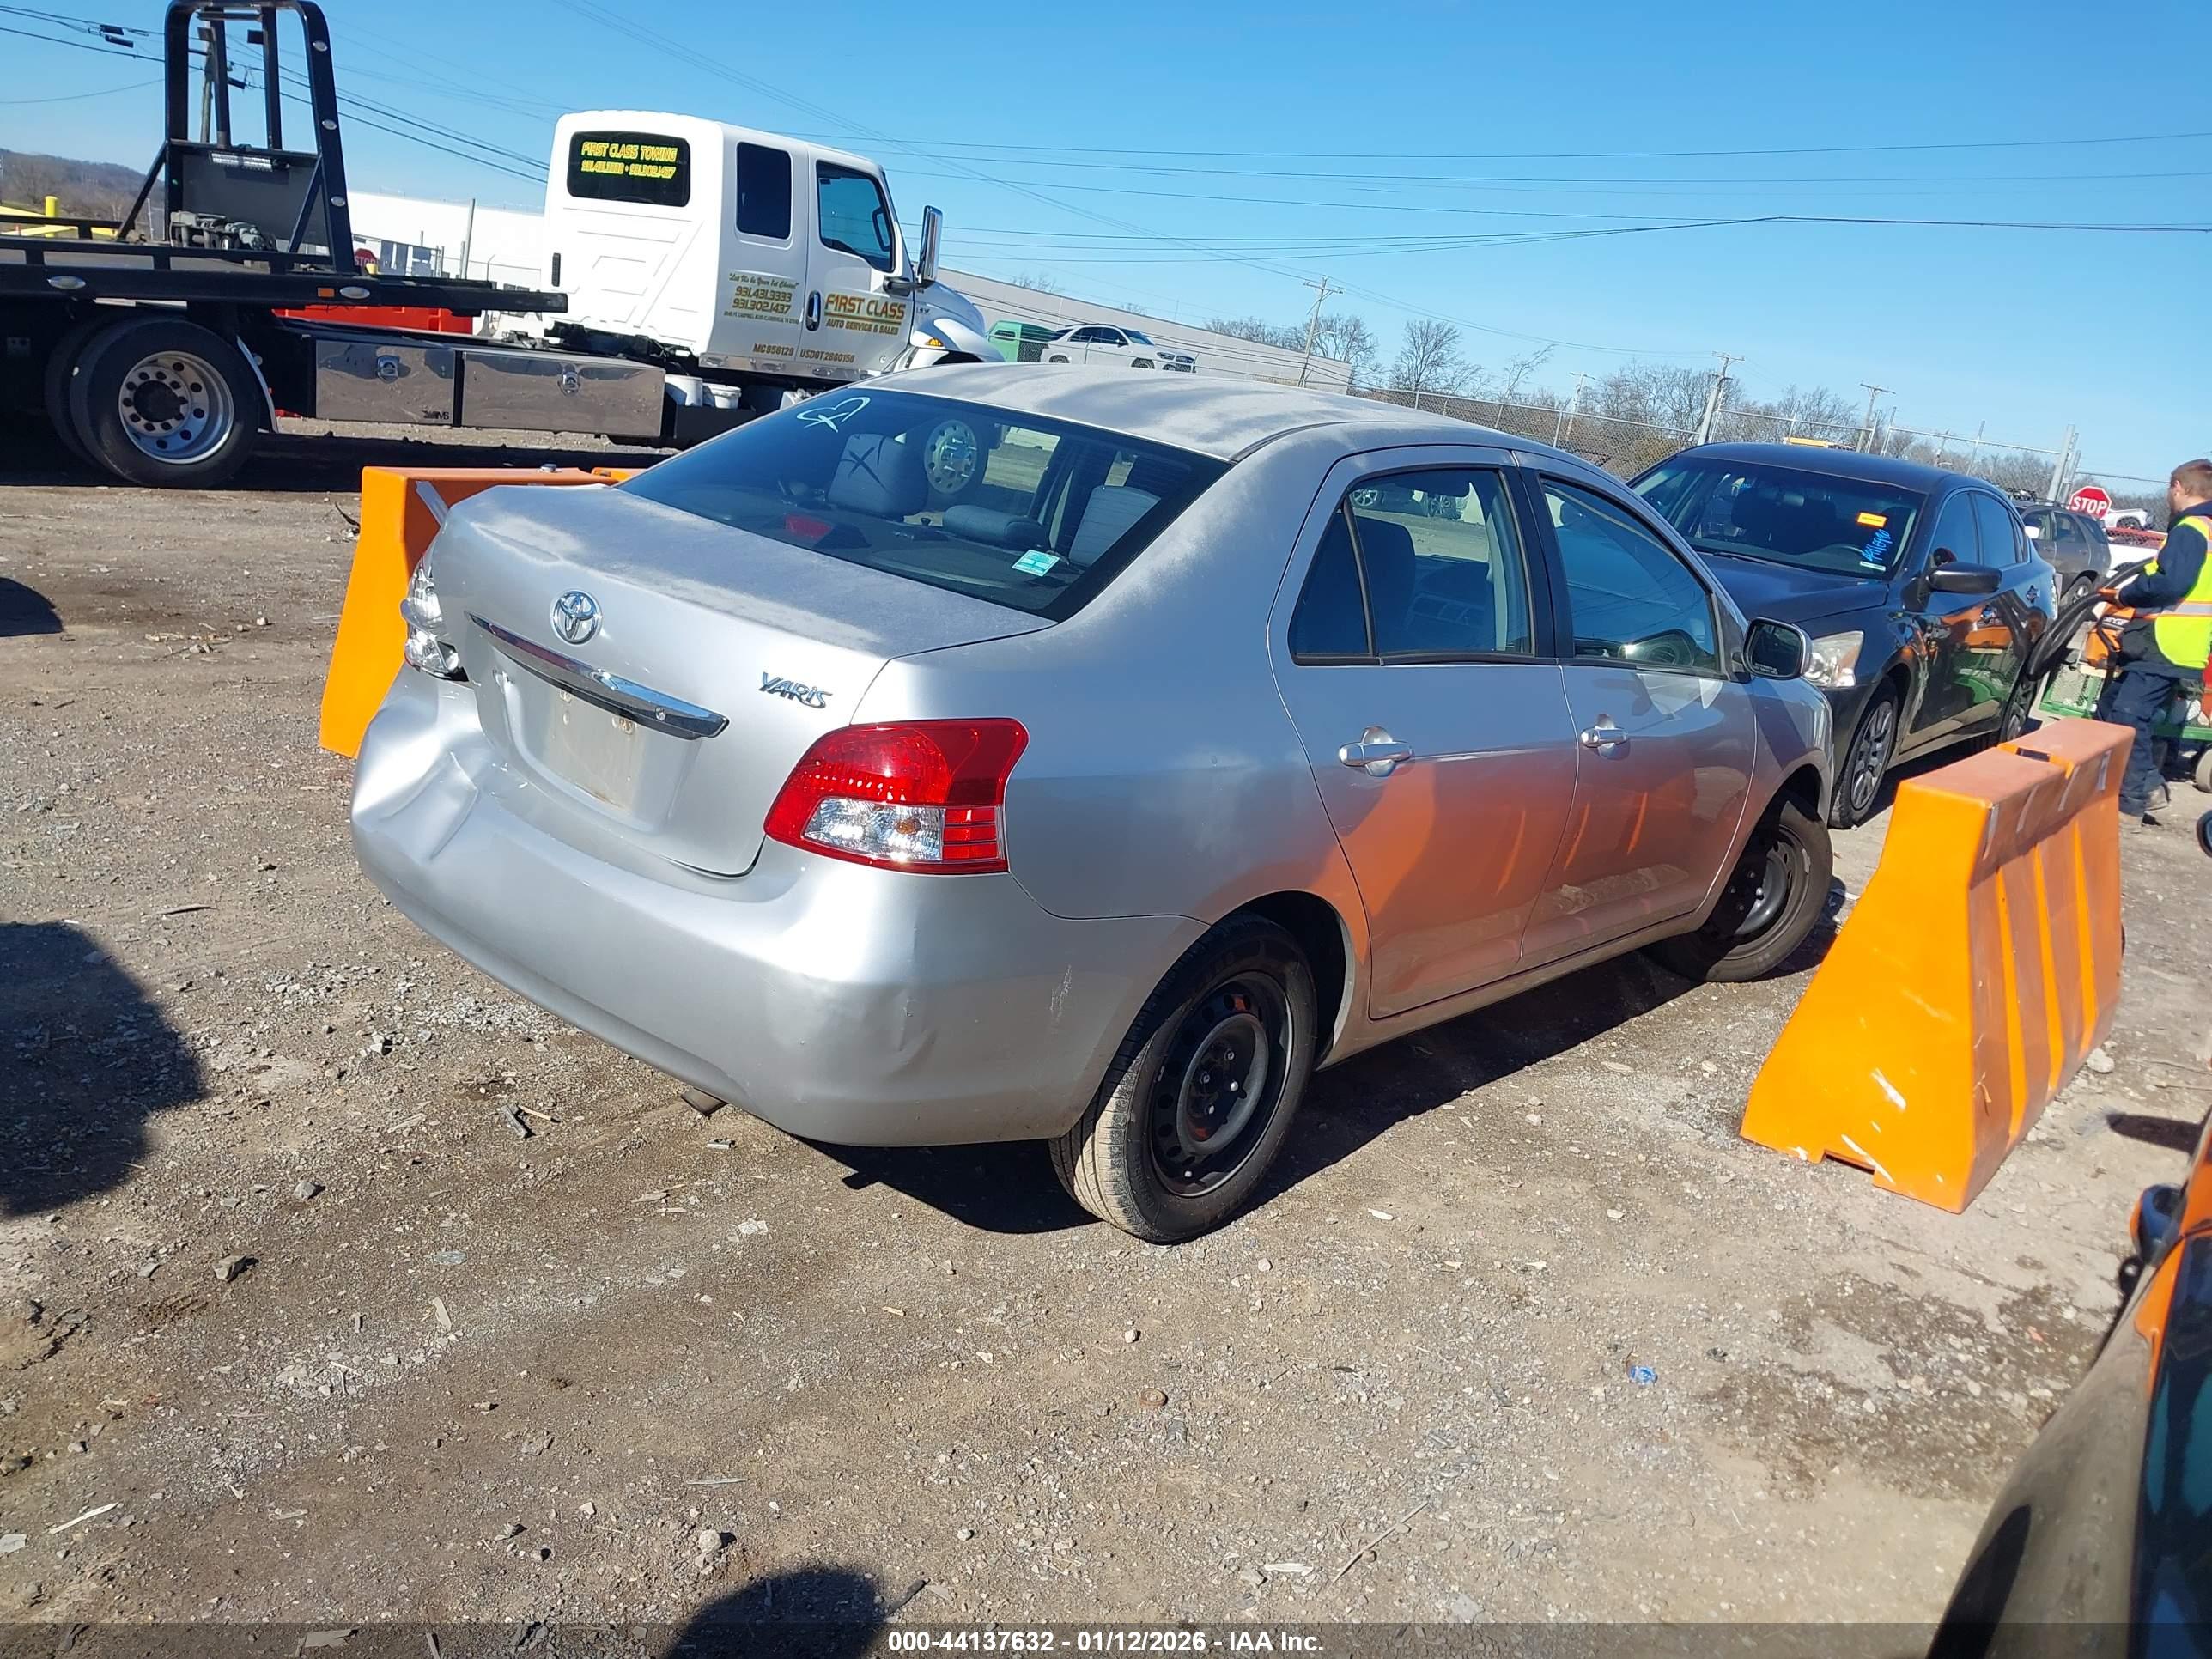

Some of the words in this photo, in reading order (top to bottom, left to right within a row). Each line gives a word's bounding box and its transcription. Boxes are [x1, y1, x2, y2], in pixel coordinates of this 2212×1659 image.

[609, 143, 639, 159] CLASS
[640, 145, 678, 162] TOWING
[735, 286, 793, 302] 931.431.3333
[732, 298, 791, 314] 931.302.1437
[866, 300, 906, 320] CLASS
[826, 319, 844, 328] AUTO
[845, 320, 873, 332] SERVICE
[2071, 496, 2107, 514] STOP
